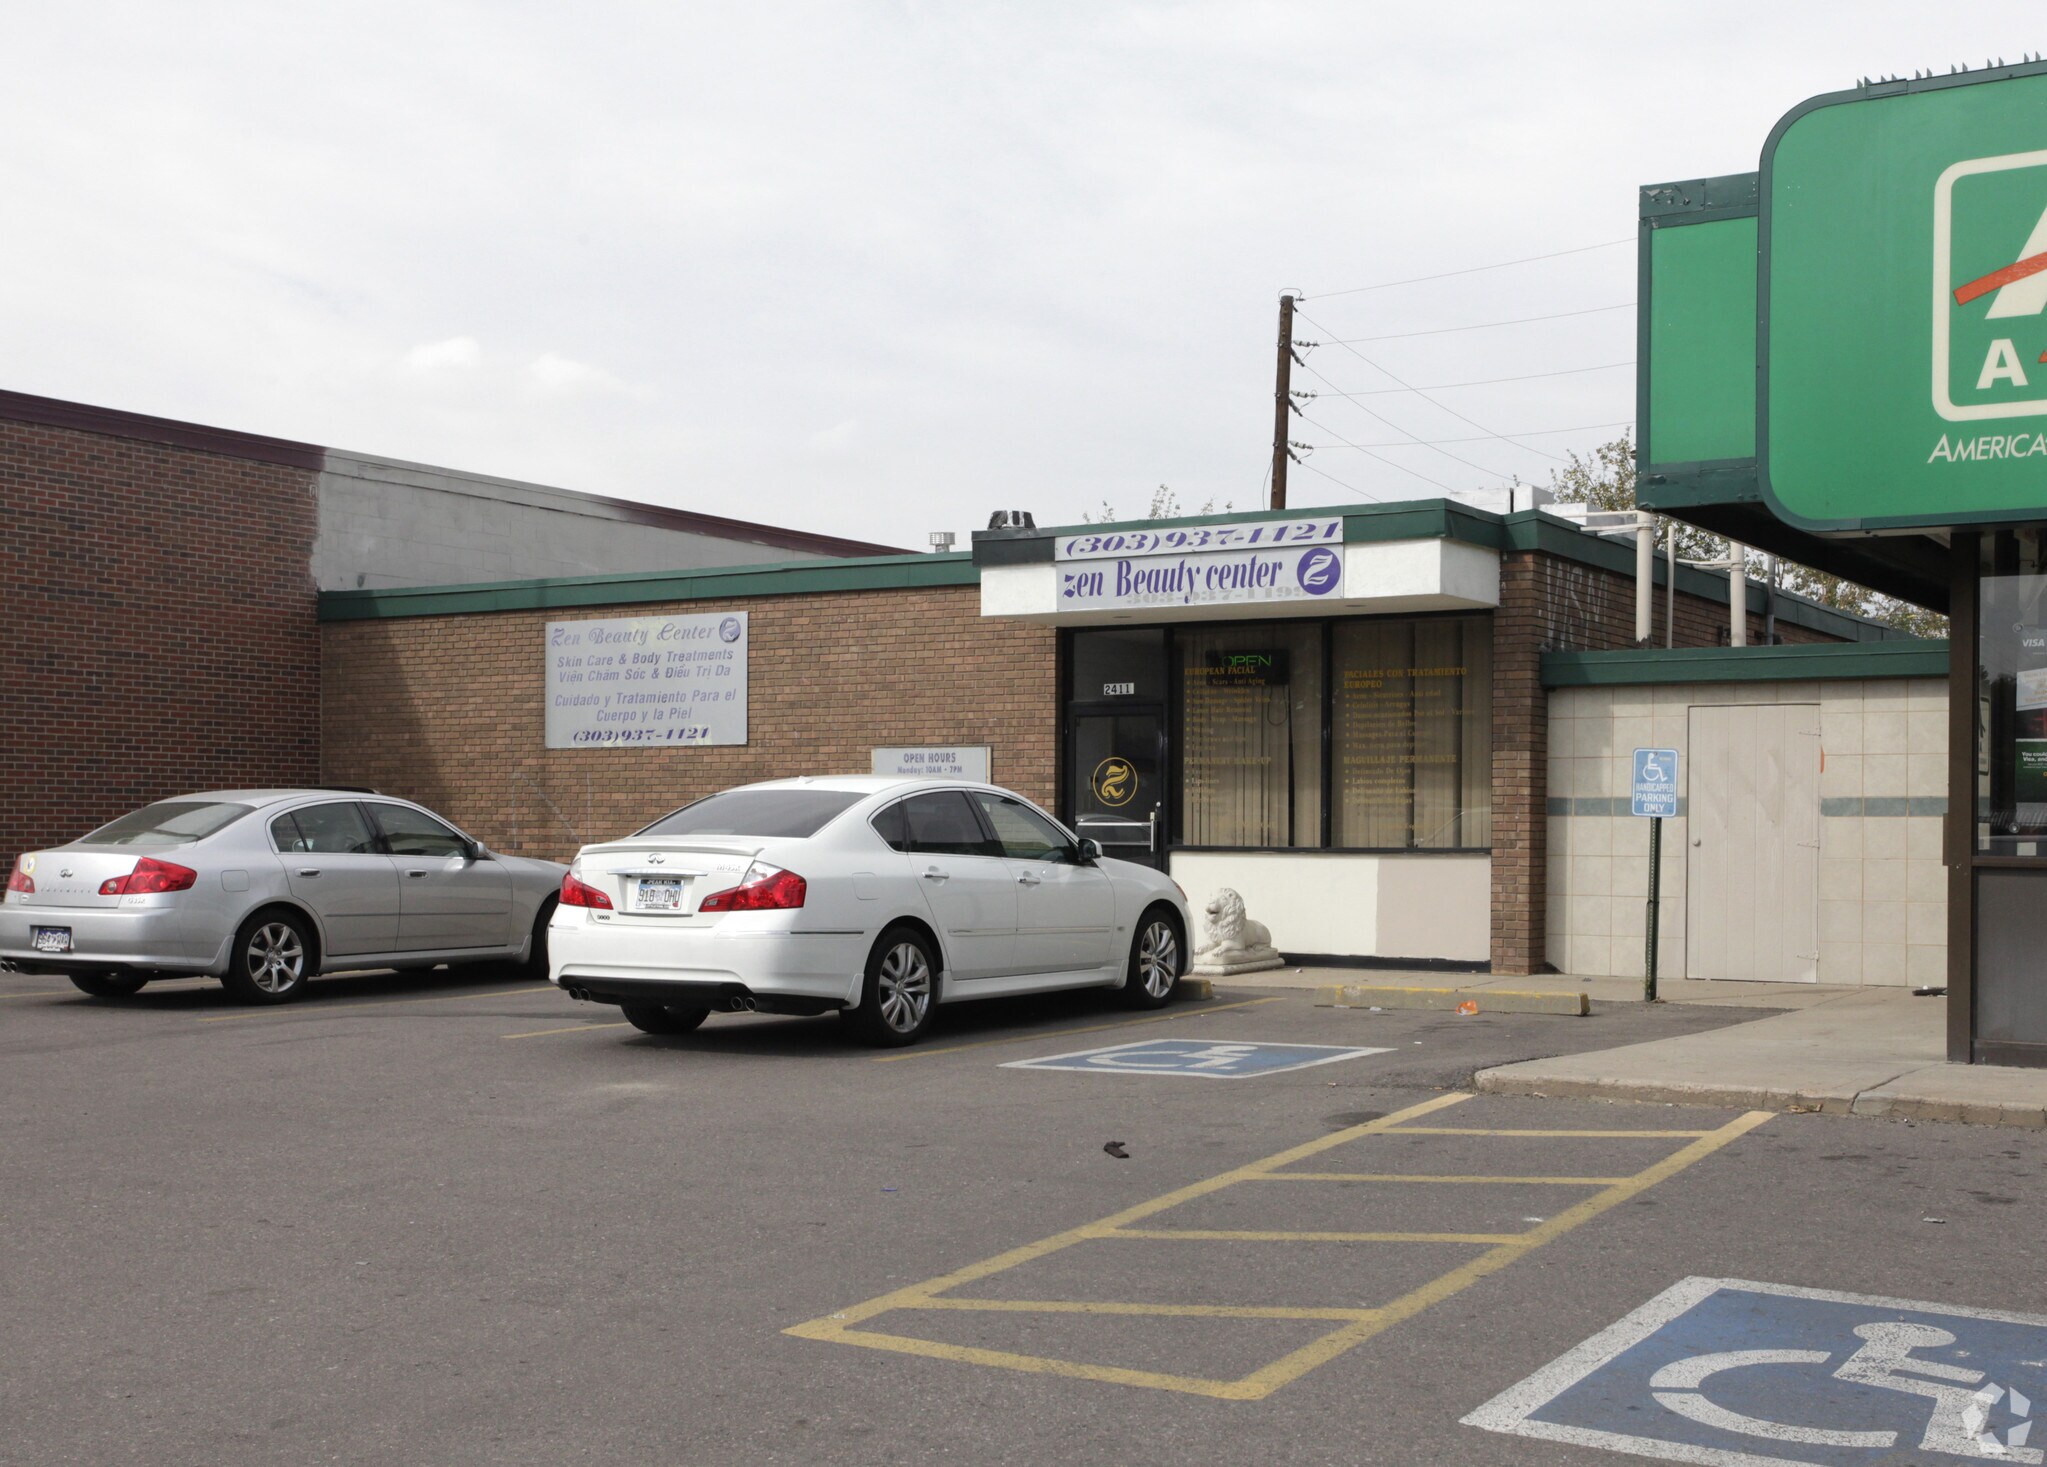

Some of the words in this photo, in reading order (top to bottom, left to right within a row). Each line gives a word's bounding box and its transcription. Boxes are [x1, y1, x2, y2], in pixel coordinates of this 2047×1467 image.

[1927, 432, 2047, 463] AMERICA
[1066, 521, 1340, 556] (303)937-1121
[1115, 558, 1200, 604] Beauty
[1206, 555, 1283, 591] center
[551, 628, 581, 647] Zen
[588, 627, 649, 646] Beauty
[656, 623, 715, 641] Center
[2022, 638, 2045, 648] VISA
[557, 656, 582, 668] Skin
[587, 654, 613, 666] Care
[619, 653, 627, 665] &
[632, 652, 661, 665] Body
[666, 649, 733, 662] Treatments
[651, 668, 659, 679] &
[715, 664, 731, 676] Da
[1105, 684, 1130, 695] 2411
[555, 695, 600, 707] Cuidado
[604, 697, 611, 708] y
[616, 691, 686, 705] Tratamiento
[692, 690, 719, 702] Para
[724, 689, 736, 701] el
[597, 710, 637, 724] Cuerpo
[641, 711, 648, 722] y
[653, 708, 663, 720] la
[669, 707, 692, 719] Piel
[573, 727, 710, 742] (303)937-1121
[903, 753, 925, 763] OPEN
[928, 752, 956, 763] HOURS
[897, 766, 924, 775] Monday:
[926, 766, 942, 774] 10AM
[949, 766, 962, 774] 7PM
[1636, 783, 1673, 792] HANDICAPPED
[1636, 793, 1673, 803] PARKING
[1643, 803, 1665, 812] ONLY
